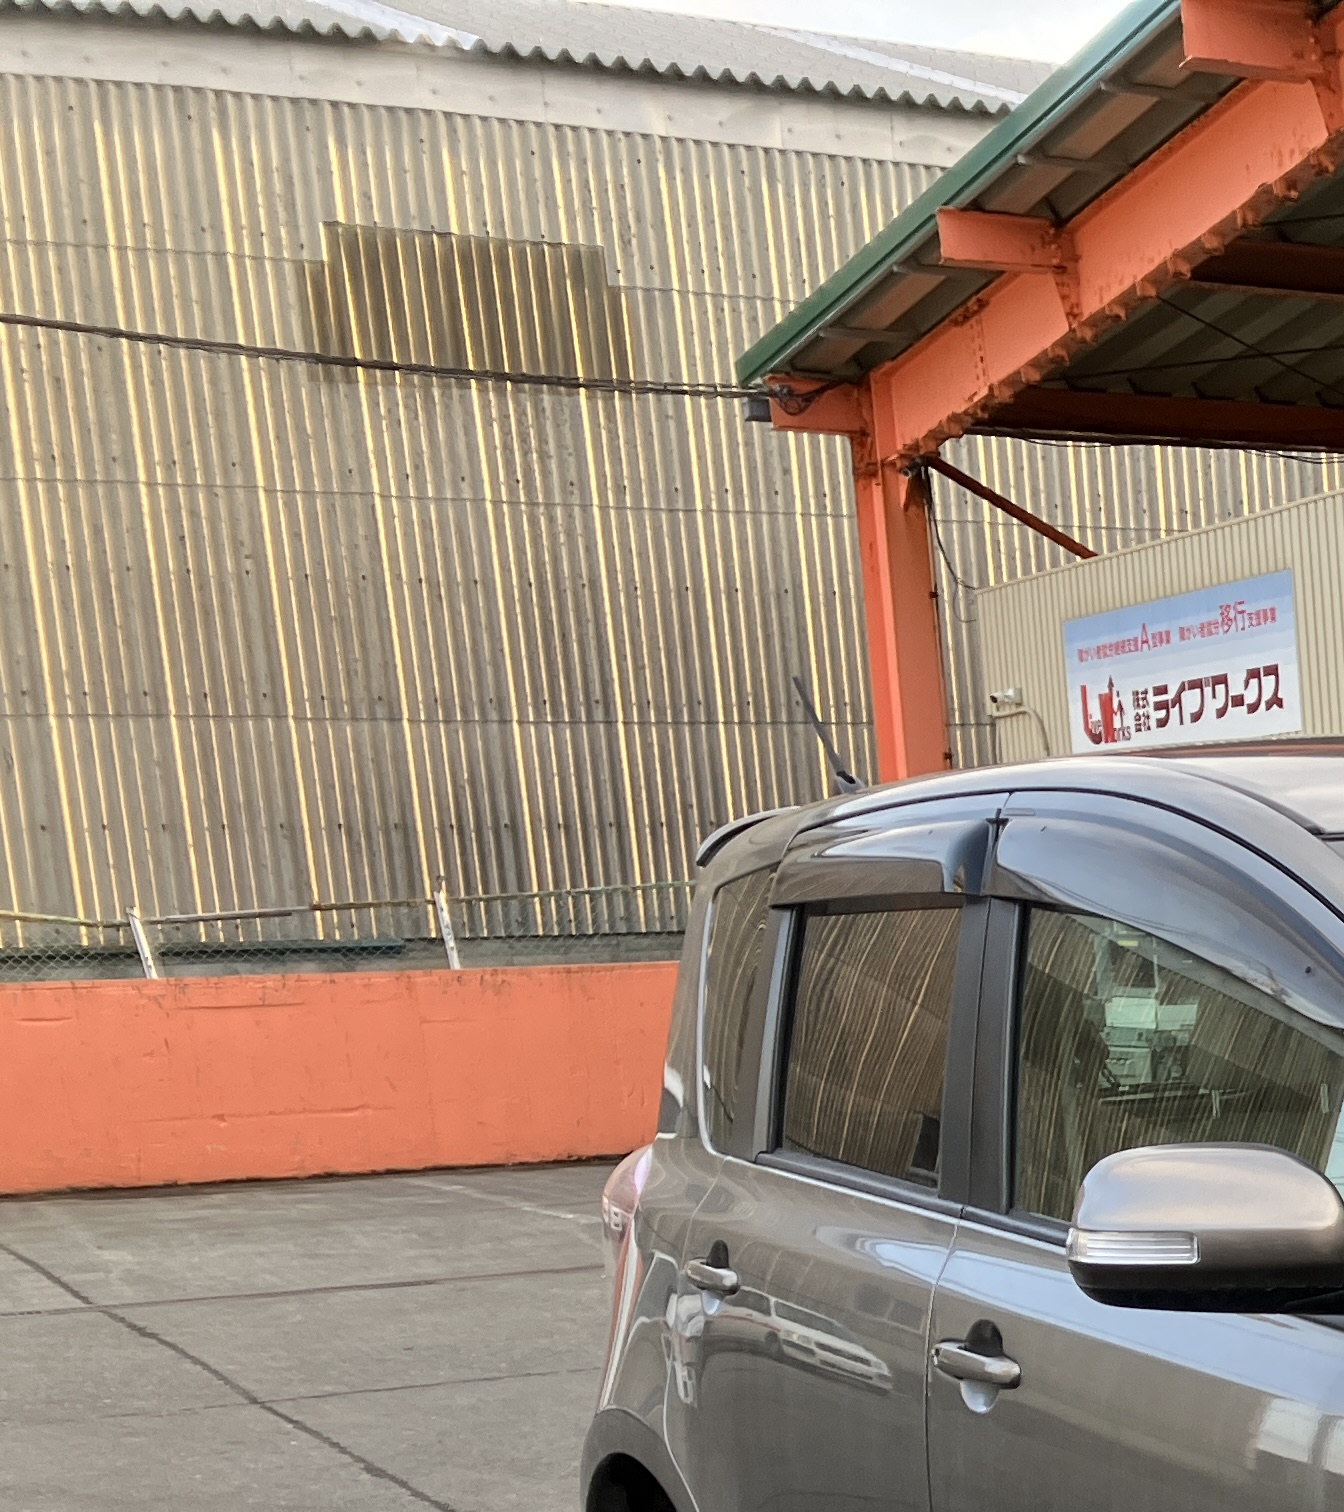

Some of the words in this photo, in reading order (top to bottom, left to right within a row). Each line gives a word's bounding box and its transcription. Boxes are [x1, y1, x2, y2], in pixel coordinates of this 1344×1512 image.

[1152, 663, 1284, 729] ライブワークス
